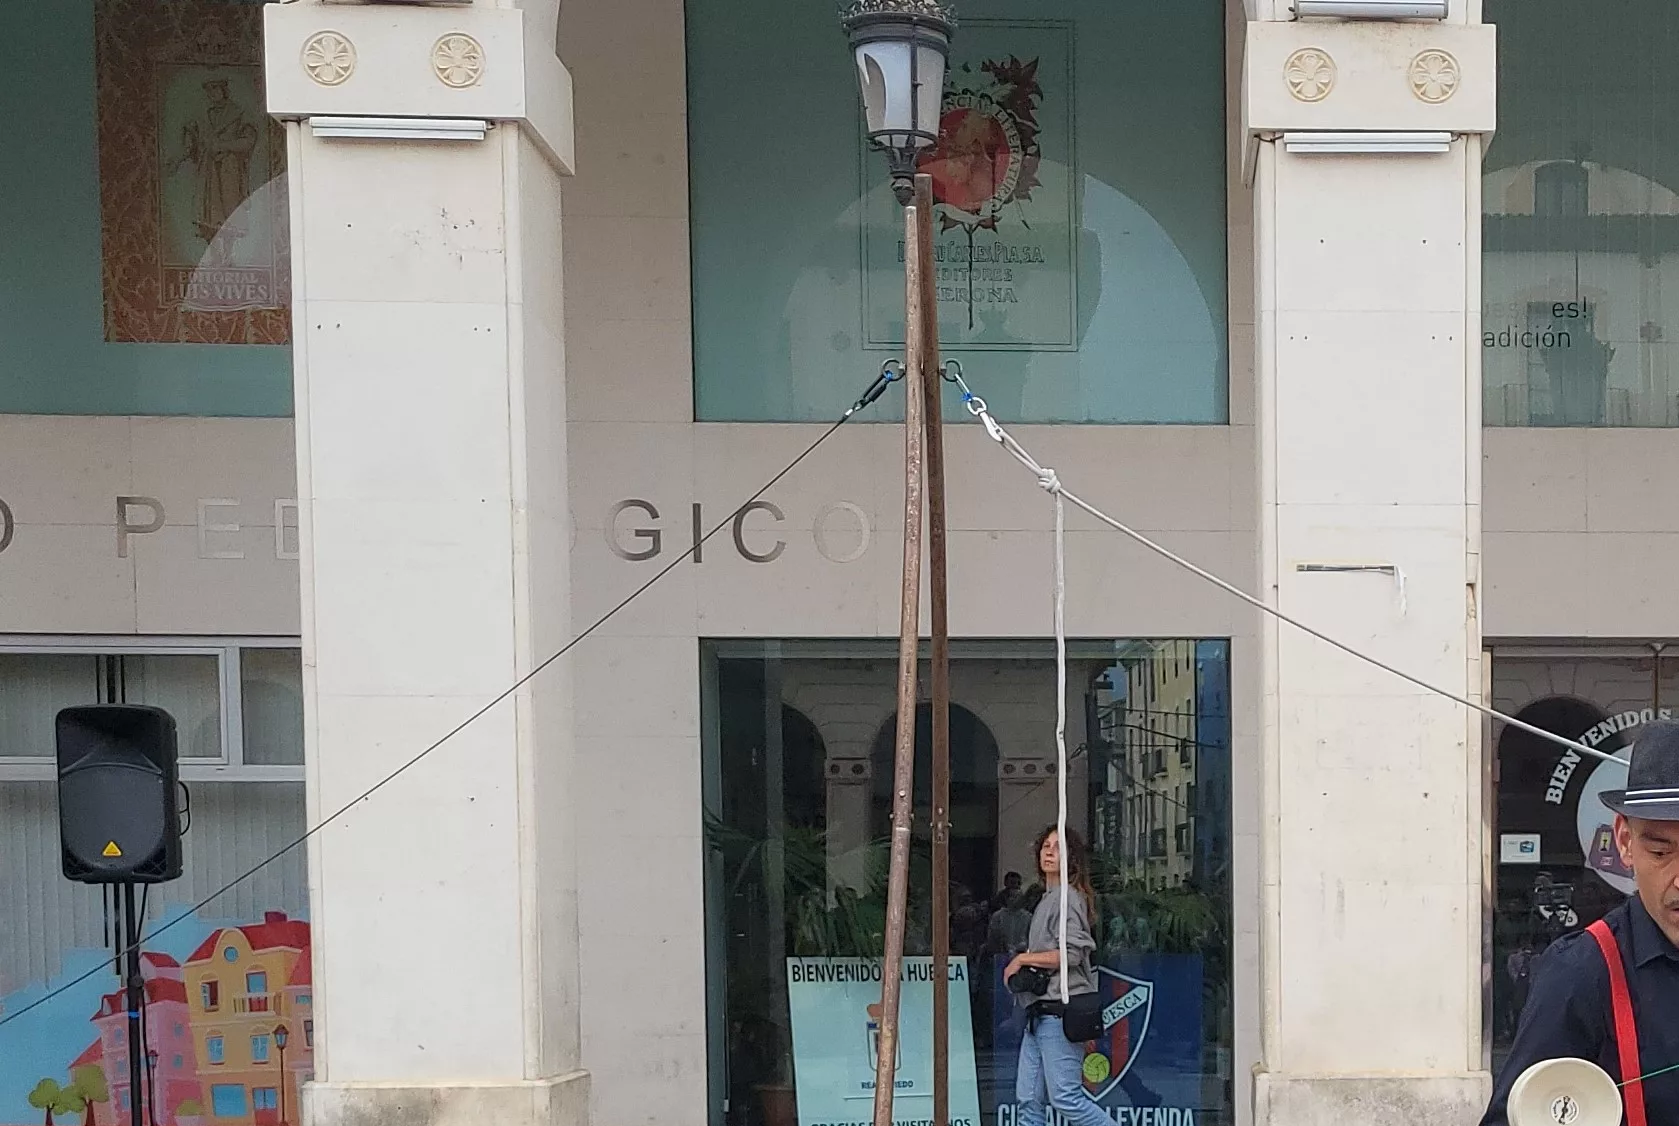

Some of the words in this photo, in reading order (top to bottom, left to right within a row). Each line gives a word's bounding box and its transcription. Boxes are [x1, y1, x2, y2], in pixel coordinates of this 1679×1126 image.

[213, 284, 269, 301] VIVES
[1552, 296, 1587, 319] es!
[1482, 324, 1571, 348] adición
[603, 498, 872, 564] GICO
[791, 963, 882, 983] BIENVENIDO
